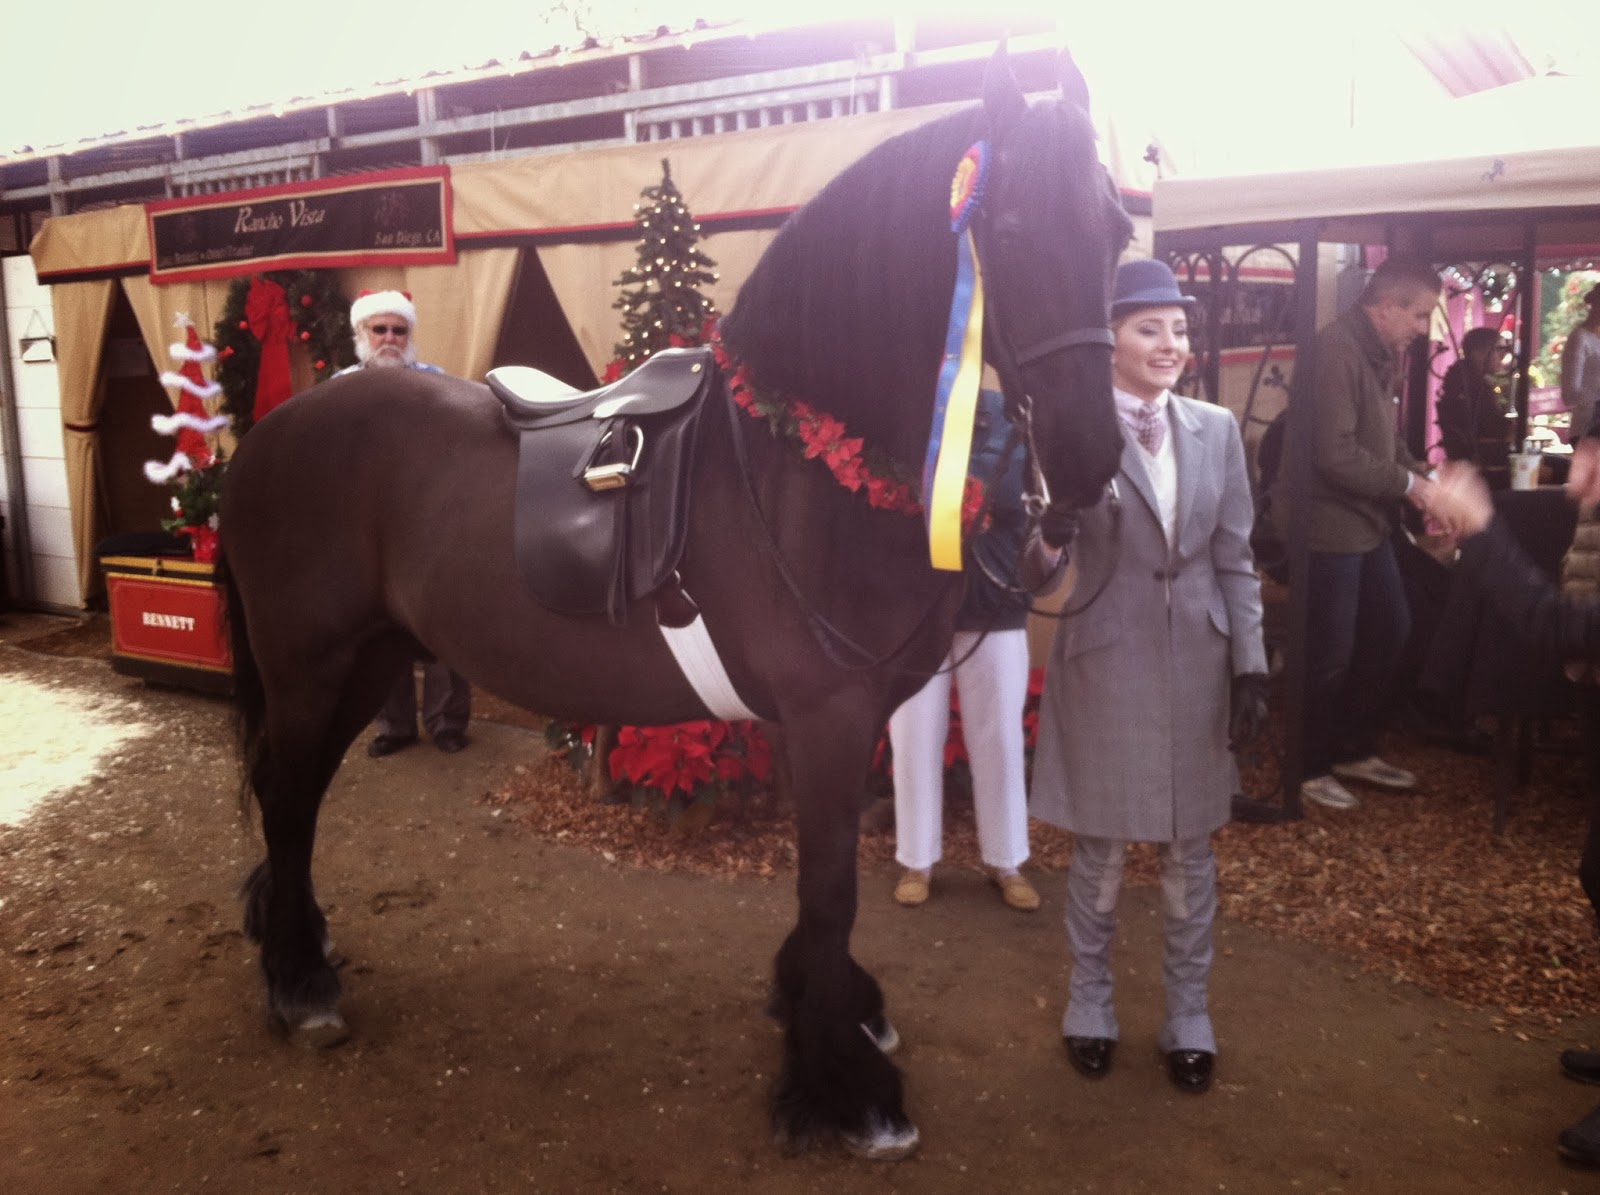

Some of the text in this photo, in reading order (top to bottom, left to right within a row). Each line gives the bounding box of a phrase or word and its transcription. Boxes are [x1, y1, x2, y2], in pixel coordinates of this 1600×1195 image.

[234, 199, 326, 233] Rancho Vista
[374, 231, 393, 246] San
[426, 229, 441, 243] CA
[142, 611, 195, 631] BENNETT
